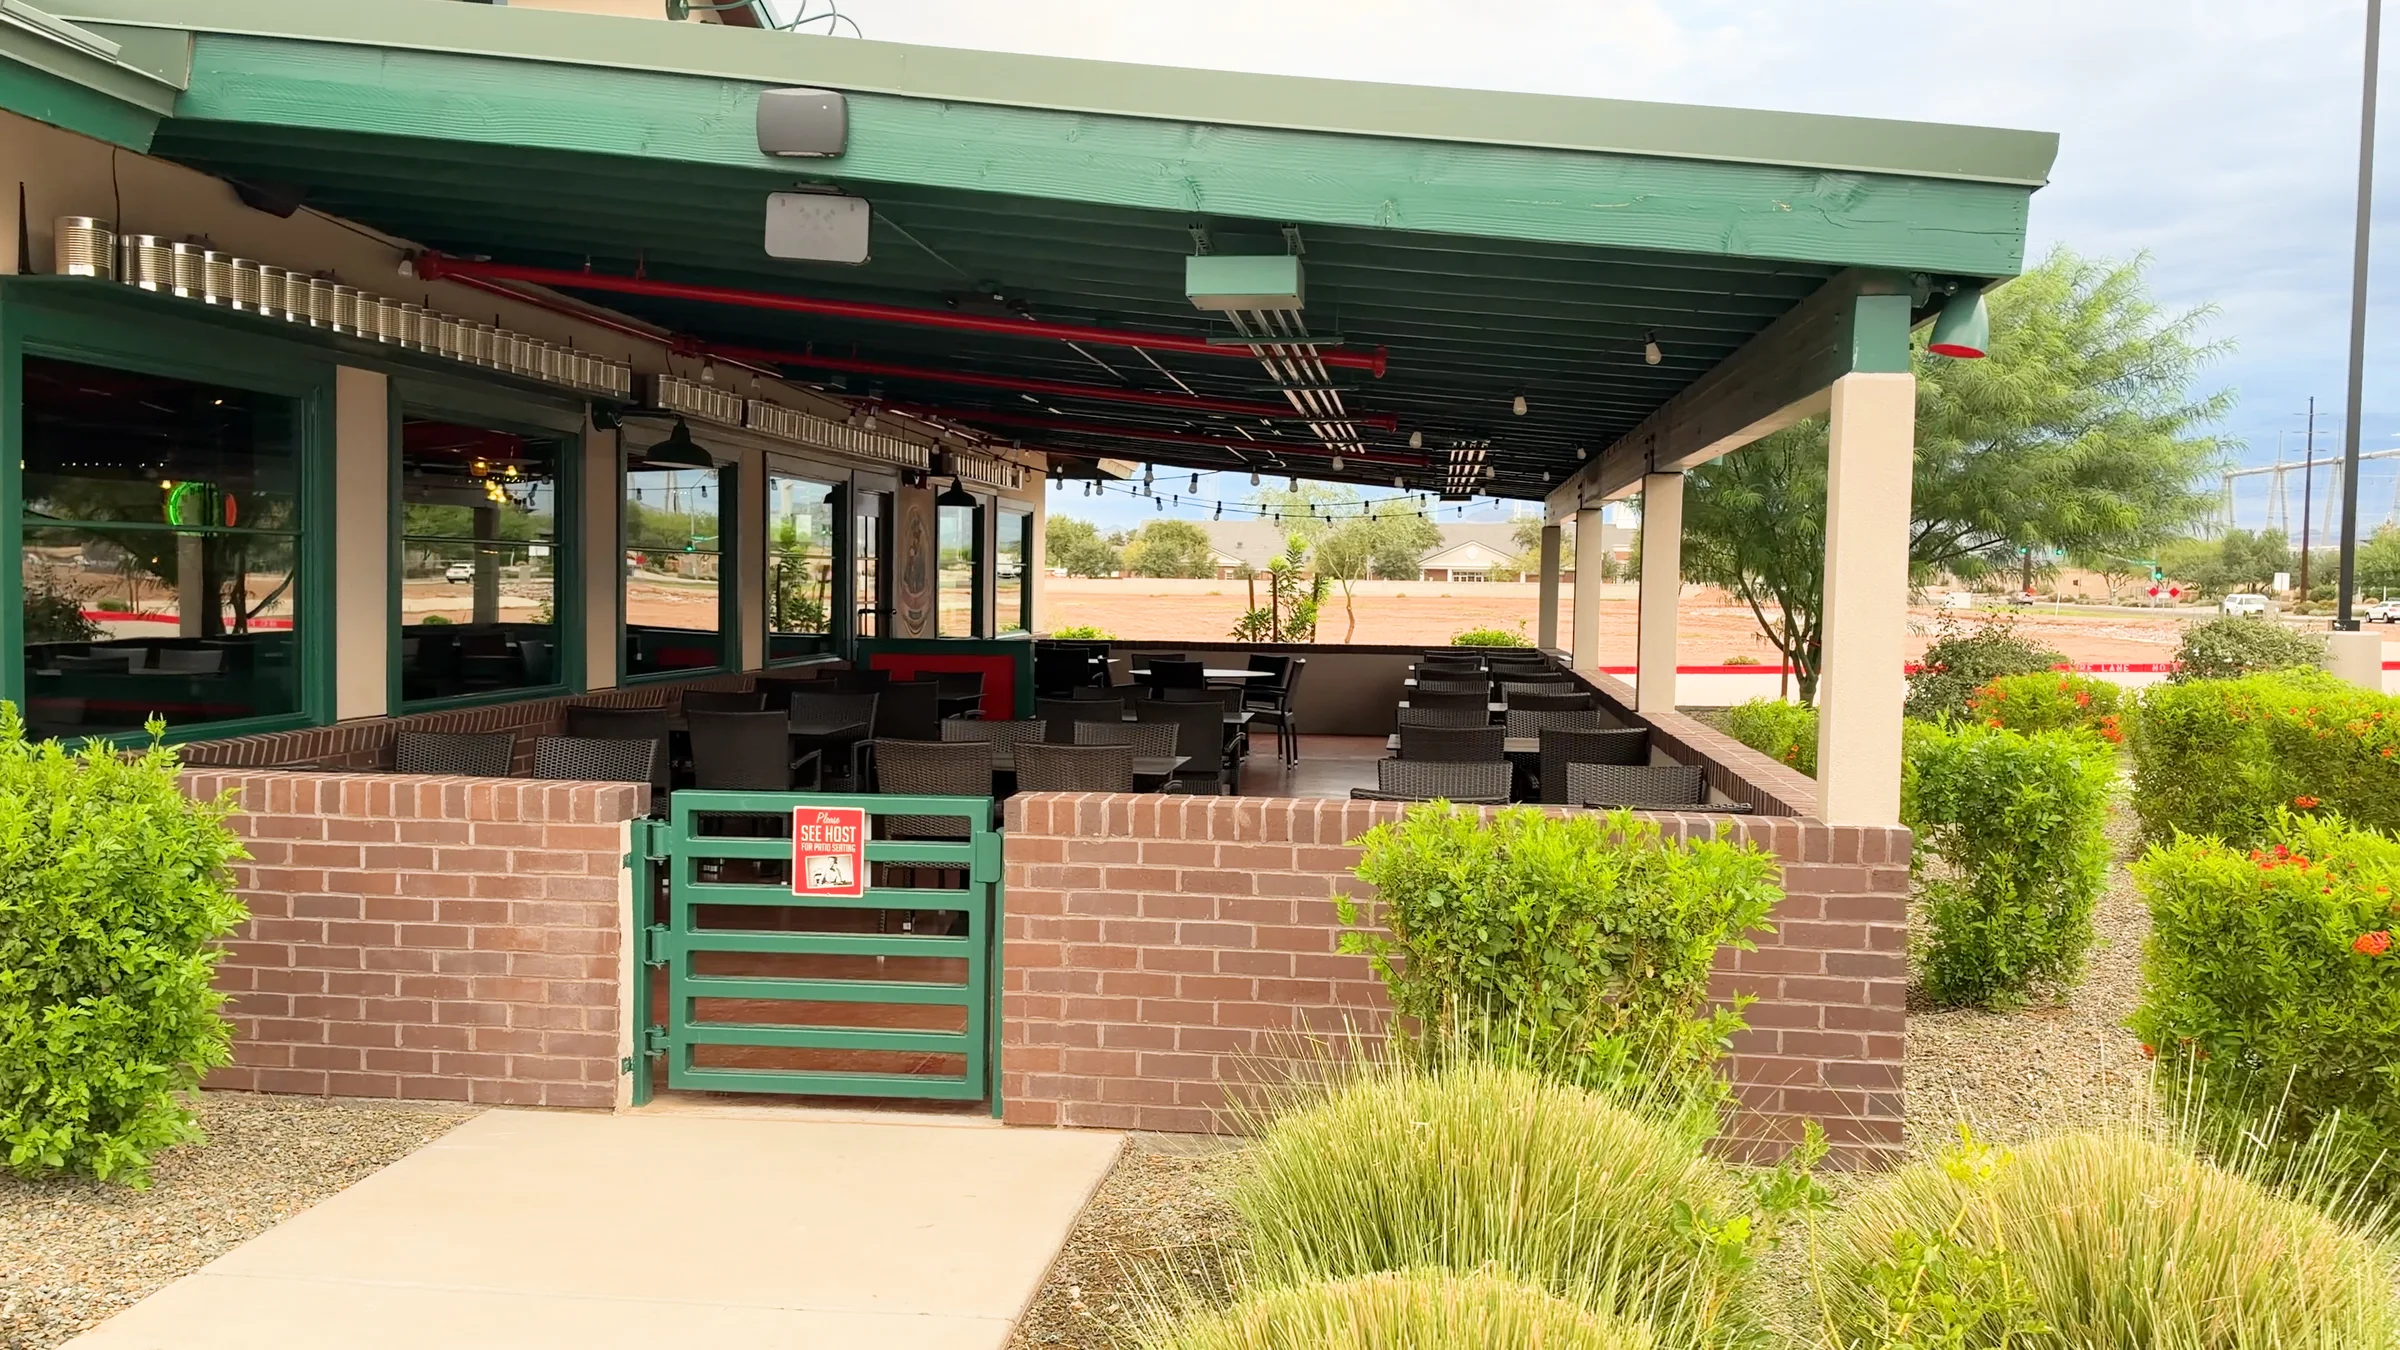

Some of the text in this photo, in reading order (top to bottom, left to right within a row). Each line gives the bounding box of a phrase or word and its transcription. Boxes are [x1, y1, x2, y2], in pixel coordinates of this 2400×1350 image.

[2101, 664, 2129, 672] LANE
[2152, 664, 2166, 672] NO
[816, 812, 841, 824] Please
[801, 824, 856, 843] SEE HOST
[801, 842, 856, 852] FOR PATIO SEATING
